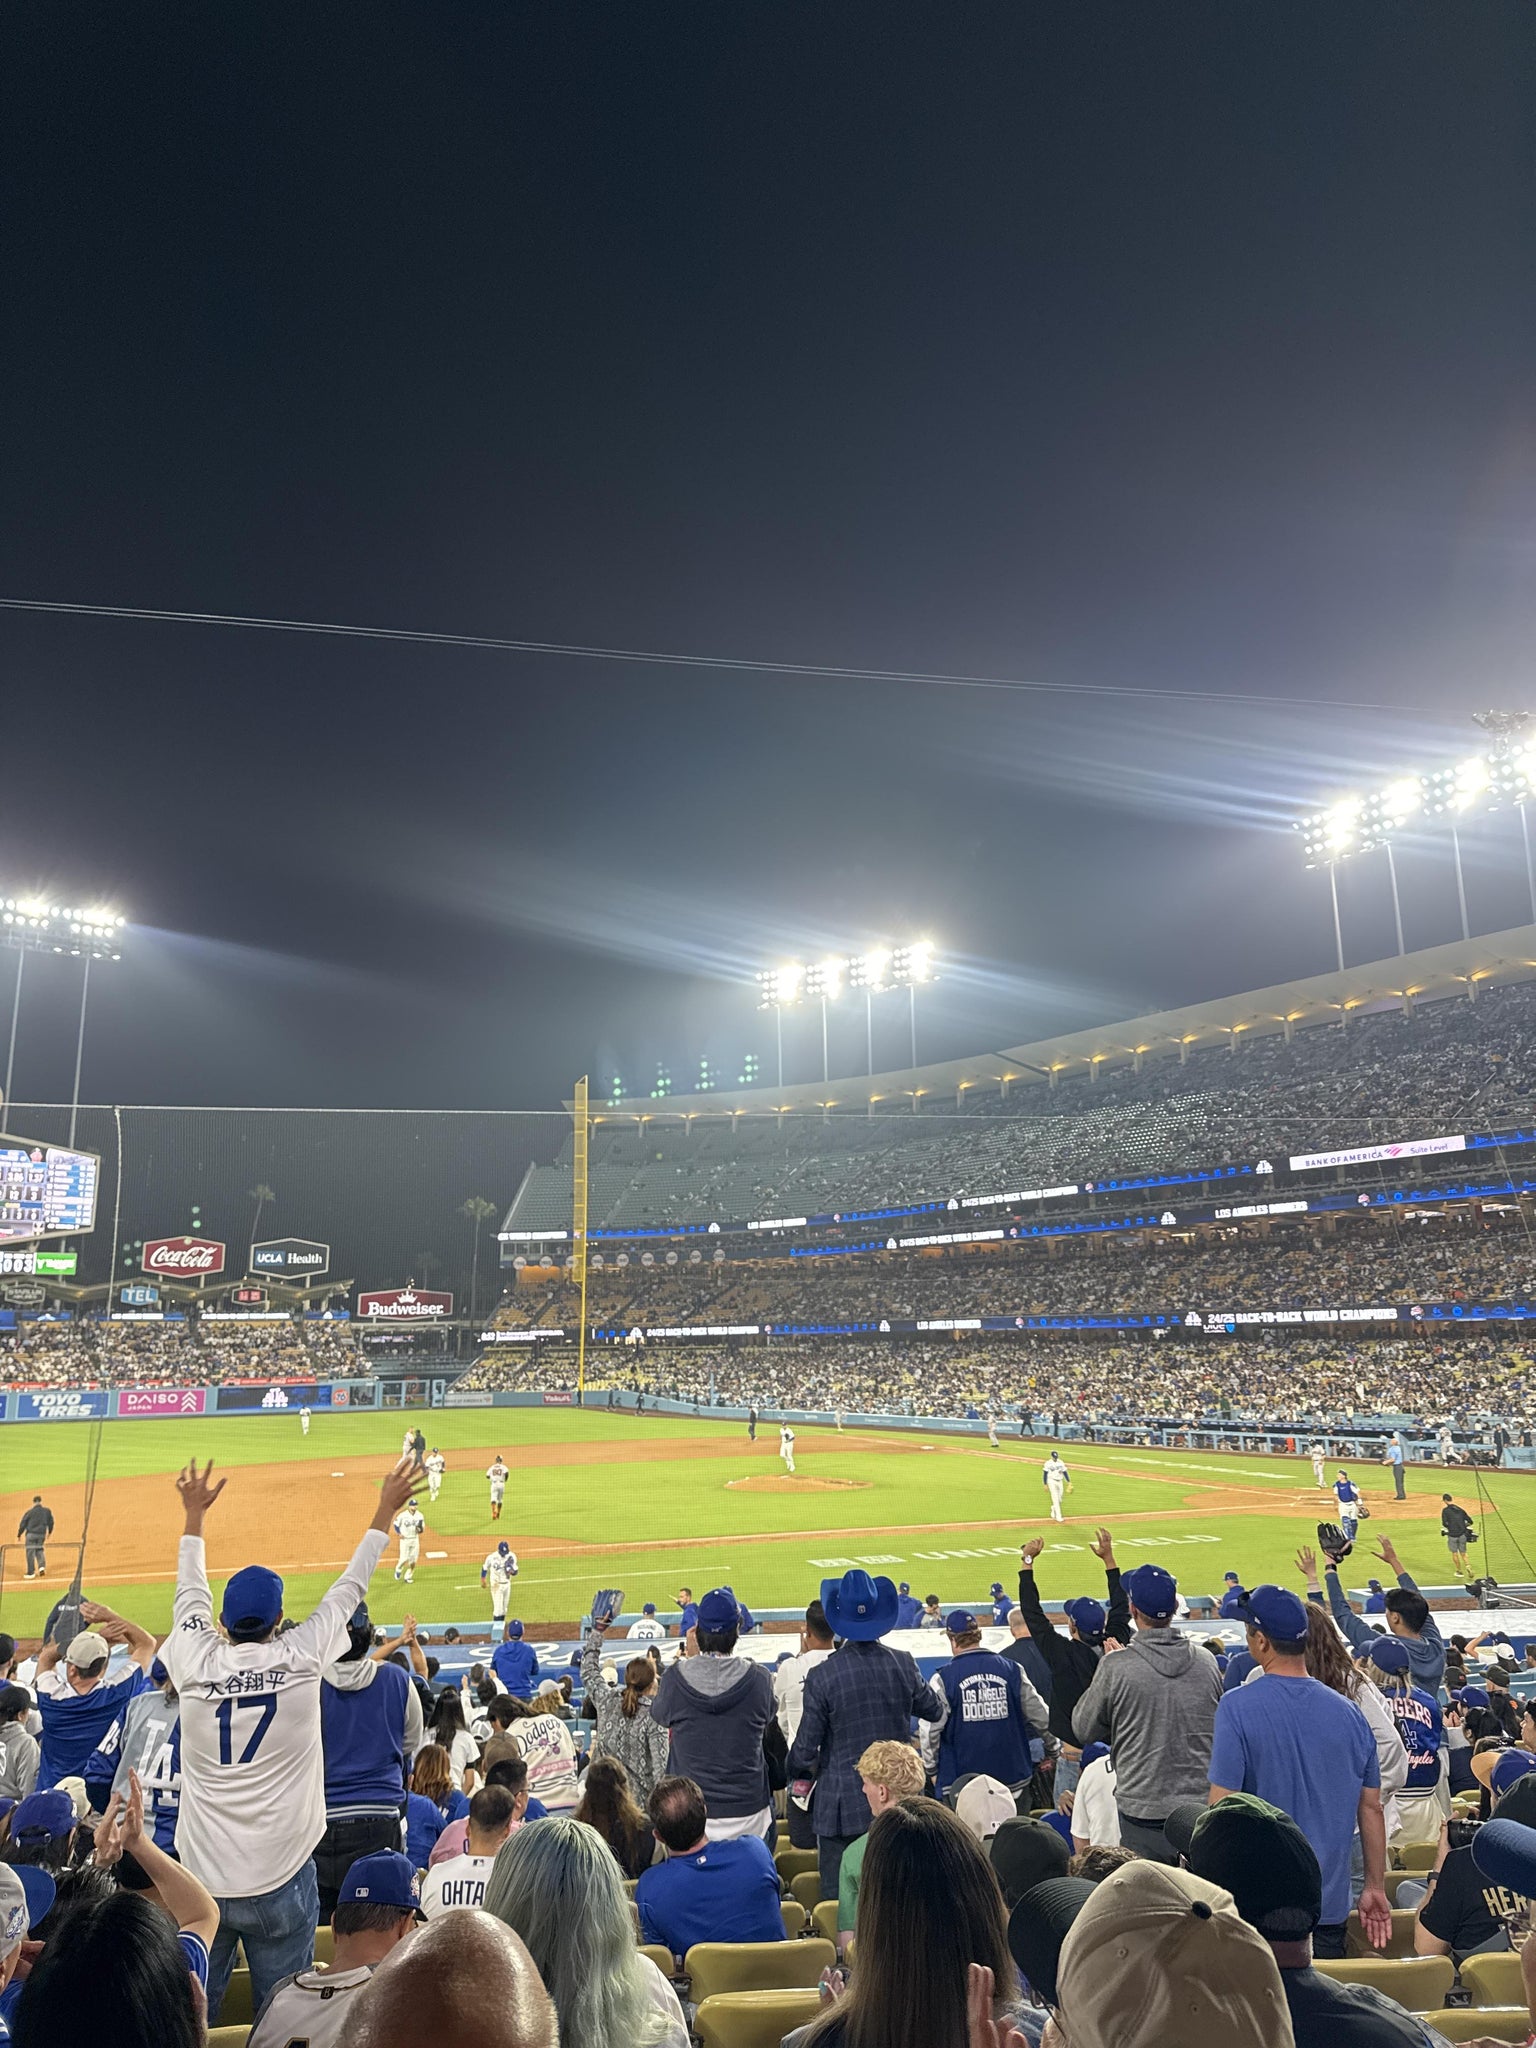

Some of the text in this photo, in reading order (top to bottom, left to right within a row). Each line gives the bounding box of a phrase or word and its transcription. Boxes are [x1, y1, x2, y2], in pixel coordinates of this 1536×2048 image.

[1410, 1143, 1448, 1155] Suite Level
[1305, 1151, 1383, 1167] BANK OF AMERICA
[1215, 1208, 1231, 1219] LOS
[150, 1246, 218, 1268] Coca-Cola
[257, 1253, 322, 1264] UCLA Health
[126, 1289, 154, 1303] TEL
[368, 1302, 444, 1316] Budweiser
[1208, 1308, 1398, 1324] 24/25 BACK-TO-BACK WORLD CHAMPIONS
[32, 1394, 82, 1407] TOYO
[127, 1394, 178, 1405] DAISO
[39, 1404, 93, 1417] TIRES
[912, 1543, 1086, 1559] UNIQO
[204, 1670, 286, 1699] 大谷翔平
[962, 1687, 1007, 1703] LOS ANGELES
[962, 1700, 1008, 1721] DODGERS
[215, 1692, 277, 1765] 17
[442, 1880, 485, 1906] OHTA
